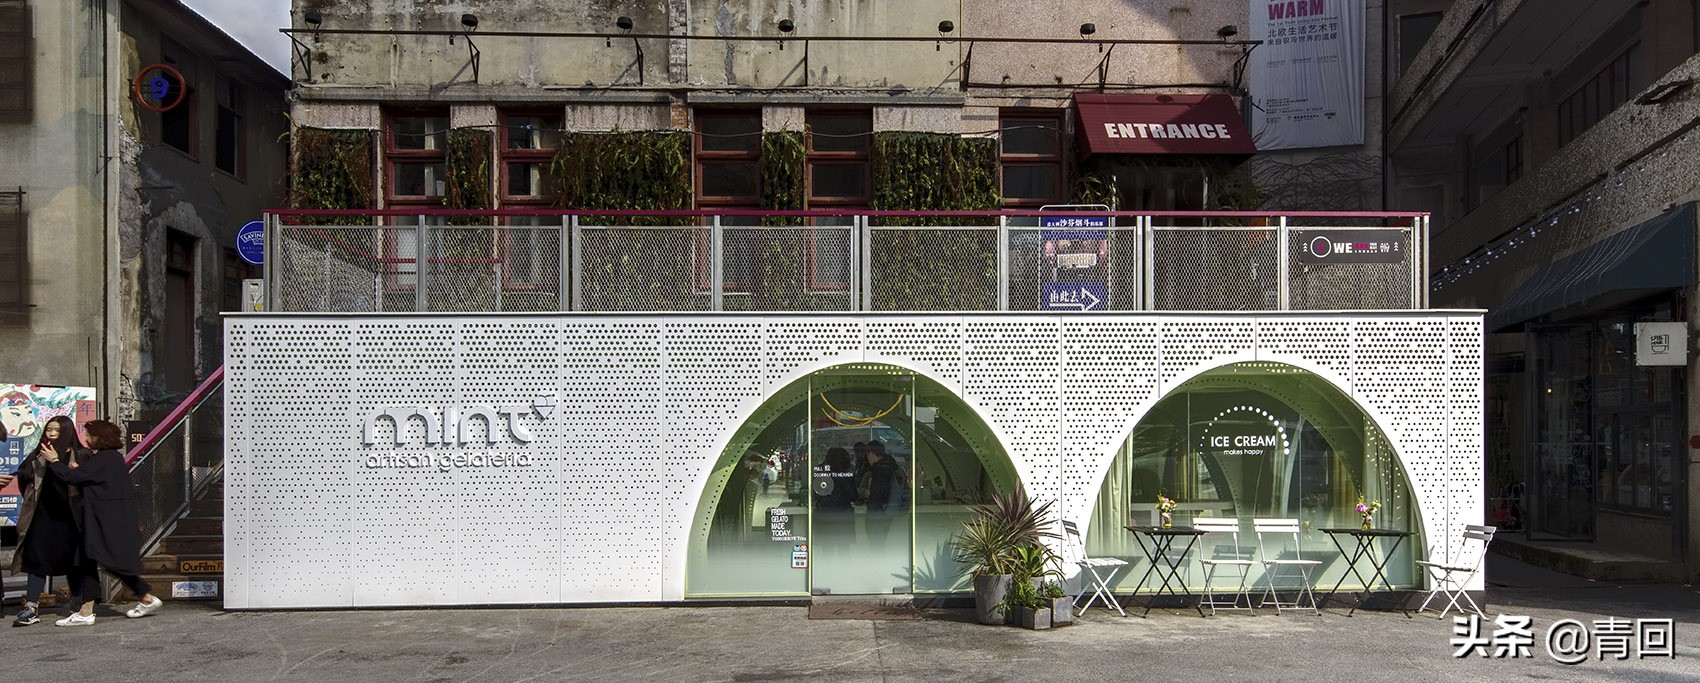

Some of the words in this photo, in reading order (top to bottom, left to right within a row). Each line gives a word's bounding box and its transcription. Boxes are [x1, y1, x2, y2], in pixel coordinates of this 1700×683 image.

[1268, 0, 1324, 20] WARM
[1267, 22, 1338, 38] 北欧生活艺术节
[151, 77, 169, 99] 9
[1104, 122, 1231, 139] ENTRANCE
[1317, 241, 1326, 253] 2
[1333, 242, 1353, 254] WE
[1049, 290, 1079, 303] 由此去
[363, 406, 530, 447] mint
[1210, 436, 1230, 447] ICE
[1234, 435, 1276, 447] CREAM
[366, 451, 432, 469] artisan
[438, 451, 532, 472] gelateria
[182, 562, 216, 571] OurFilm
